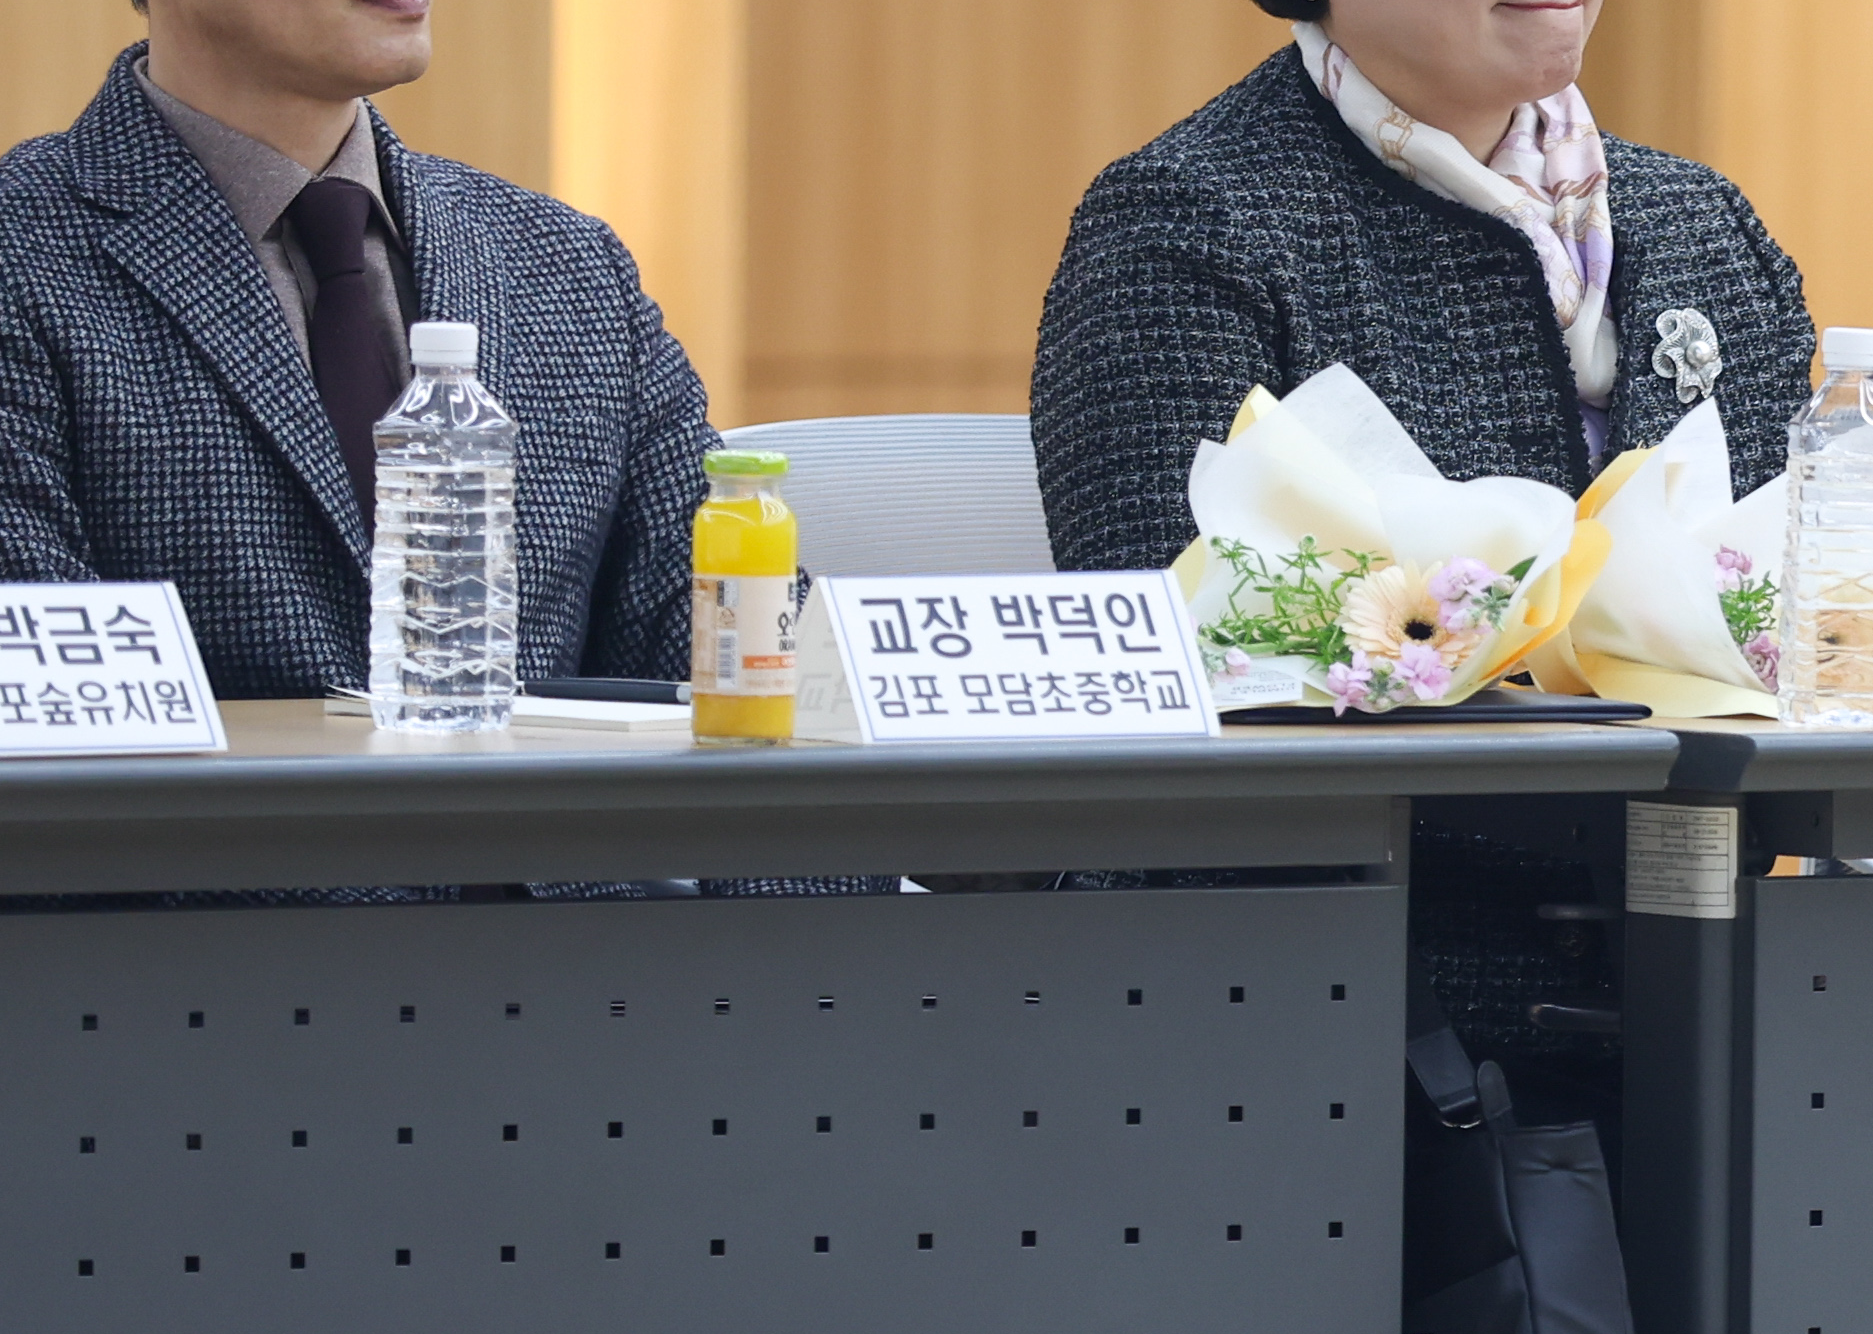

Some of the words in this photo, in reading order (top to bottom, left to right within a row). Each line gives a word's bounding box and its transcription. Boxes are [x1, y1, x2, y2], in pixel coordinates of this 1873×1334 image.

[0, 605, 162, 665] 박금숙
[860, 595, 972, 658] 교장
[991, 593, 1161, 655] 박덕인
[0, 680, 196, 725] 포숲유치원
[870, 675, 949, 718] 김포
[960, 670, 1190, 716] 모담초중학교
